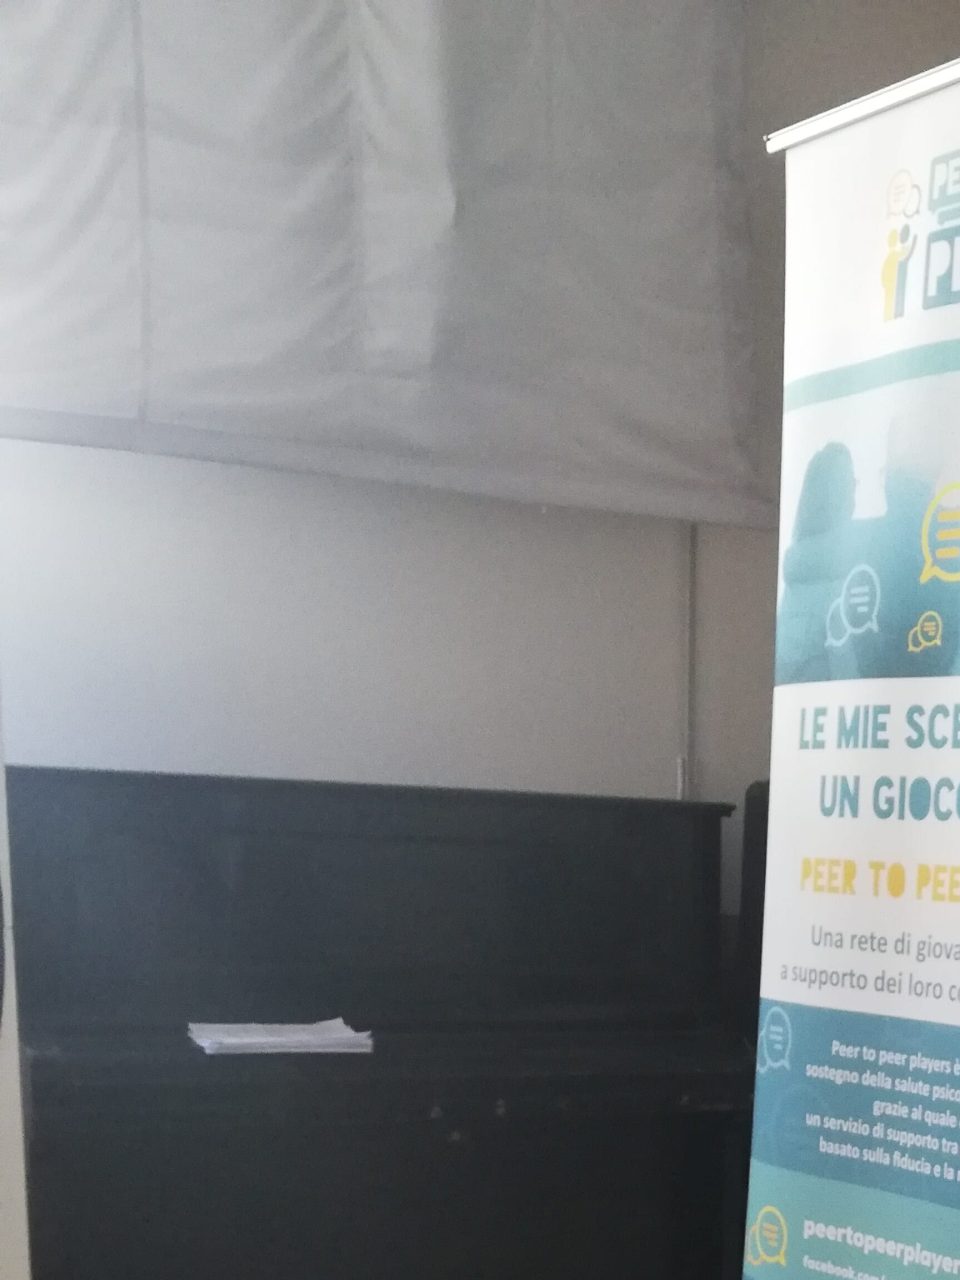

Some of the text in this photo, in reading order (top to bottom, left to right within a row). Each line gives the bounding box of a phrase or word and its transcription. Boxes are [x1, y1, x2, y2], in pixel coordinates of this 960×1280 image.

[799, 707, 828, 750] LE
[836, 705, 891, 749] MIE
[819, 775, 860, 818] UN
[801, 857, 857, 896] PEER
[869, 861, 906, 898] TO
[811, 924, 844, 950] Una
[849, 932, 888, 954] rete
[894, 931, 911, 956] di
[780, 965, 788, 981] a
[791, 966, 868, 992] supporto
[874, 969, 902, 995] dei
[908, 973, 944, 1001] loro
[831, 1040, 859, 1059] Peer
[862, 1046, 876, 1061] to
[879, 1049, 907, 1066] peer
[909, 1052, 951, 1073] players
[806, 1064, 859, 1086] sostegno
[861, 1070, 892, 1090] della
[894, 1076, 930, 1097] salute
[872, 1100, 909, 1118] grazie
[911, 1104, 922, 1121] al
[924, 1110, 958, 1128] quale
[806, 1113, 821, 1127] un
[823, 1116, 870, 1136] servizio
[872, 1122, 884, 1138] di
[887, 1127, 939, 1151] supporto
[942, 1137, 958, 1155] tra
[819, 1136, 860, 1159] basato
[862, 1147, 890, 1165] sulla
[893, 1150, 932, 1175] fiducia
[933, 1165, 941, 1177] e
[943, 1162, 954, 1181] la
